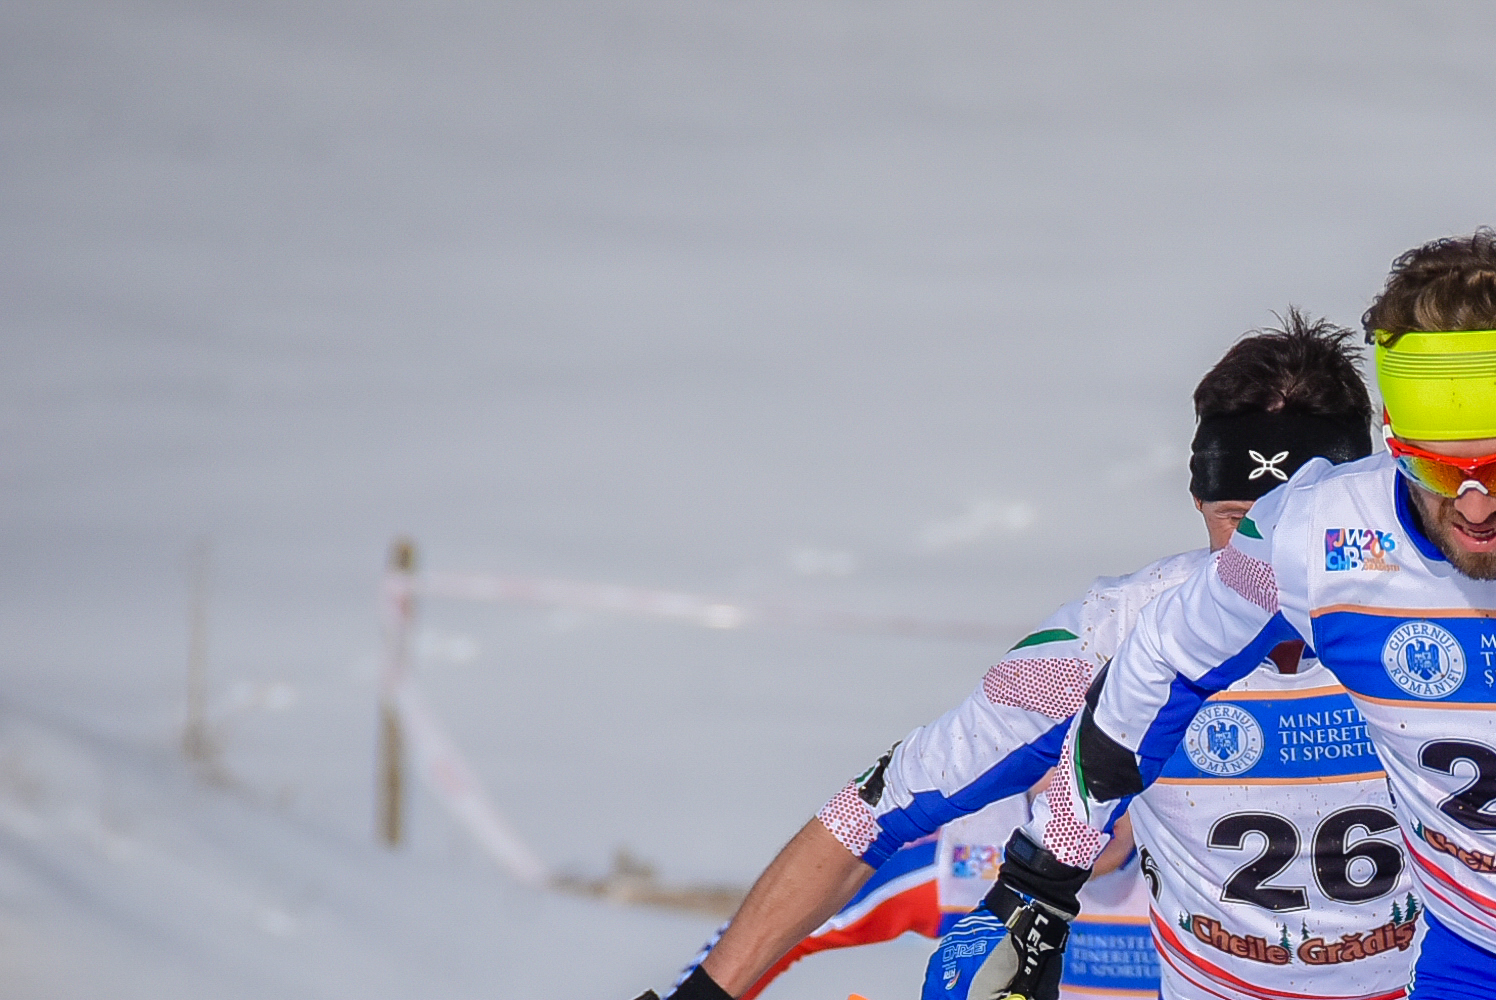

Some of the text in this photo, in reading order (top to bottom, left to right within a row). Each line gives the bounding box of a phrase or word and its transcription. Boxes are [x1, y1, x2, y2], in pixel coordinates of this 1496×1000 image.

[1389, 623, 1454, 652] GUVERNUL
[1391, 668, 1462, 697] ROMÂNIEI
[1190, 705, 1258, 733] GUVERNUL
[1190, 744, 1258, 773] ROMÂNIEI
[1207, 805, 1405, 913] 26
[1027, 913, 1049, 966] LEKI
[1190, 914, 1292, 965] Cheile
